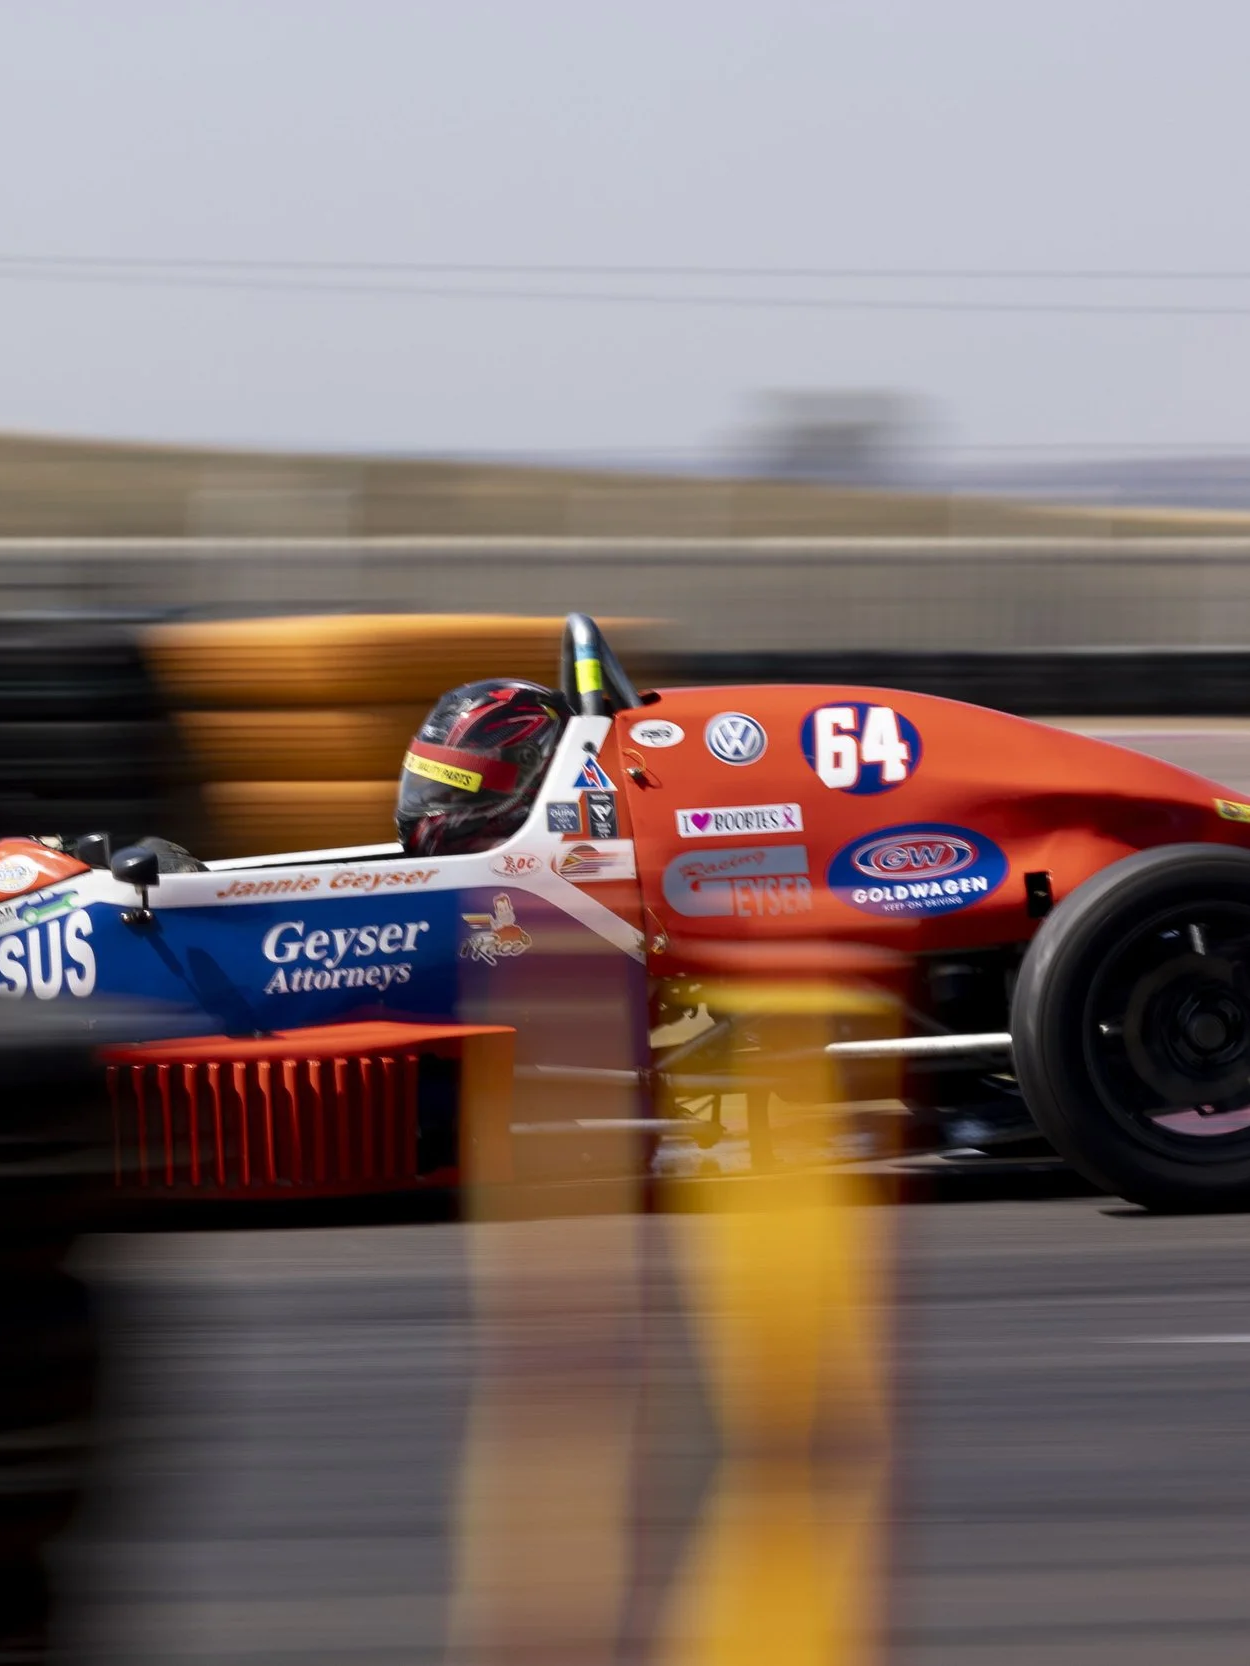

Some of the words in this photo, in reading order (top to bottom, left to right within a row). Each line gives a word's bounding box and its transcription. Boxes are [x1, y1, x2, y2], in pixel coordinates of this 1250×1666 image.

[710, 714, 761, 760] VW
[814, 706, 909, 789] 64
[713, 809, 780, 832] BOOBIES
[678, 851, 766, 879] Racing
[880, 844, 946, 871] GW
[216, 874, 320, 899] Jannie
[329, 868, 440, 892] Geyser
[852, 876, 989, 904] GOLDWAGEN
[882, 902, 905, 912] KEEP
[906, 900, 922, 910] ON
[925, 896, 964, 908] DRIVING
[262, 920, 431, 969] Geyser
[263, 961, 413, 995] Attorneys
